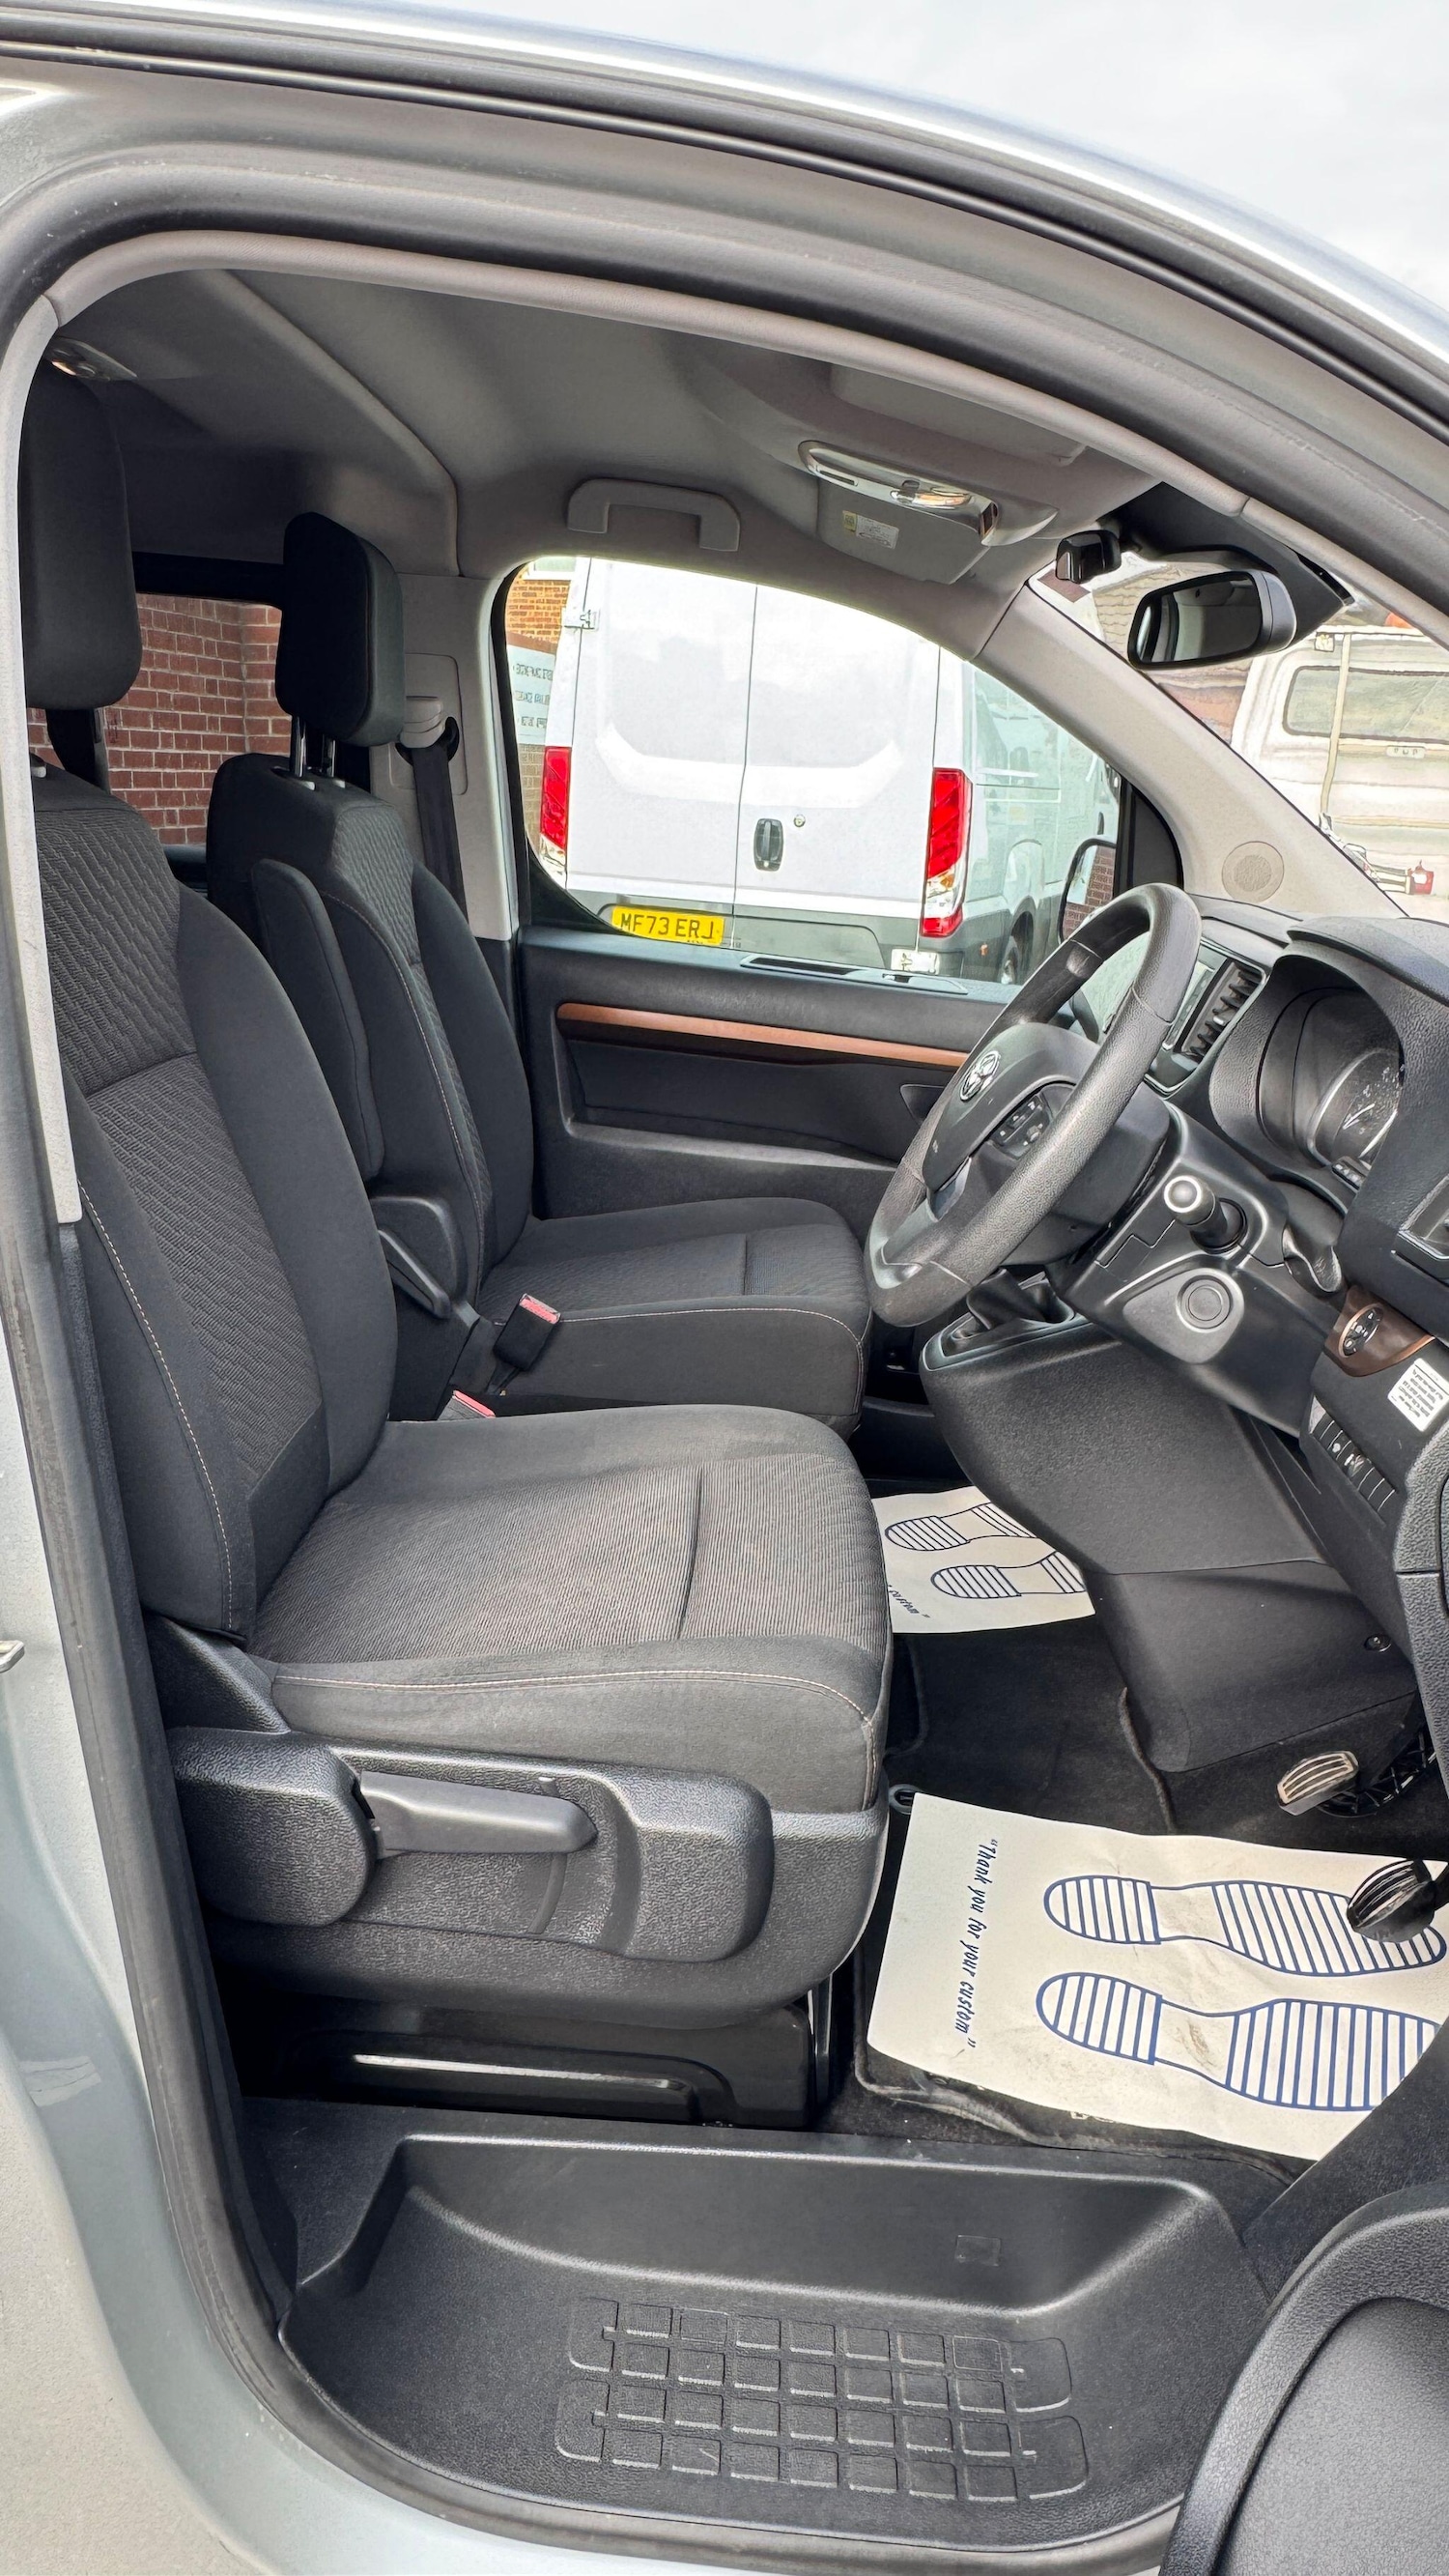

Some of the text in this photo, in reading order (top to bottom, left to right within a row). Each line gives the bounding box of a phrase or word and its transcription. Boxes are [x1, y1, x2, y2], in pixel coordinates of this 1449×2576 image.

[675, 918, 714, 939] ERJ
[967, 1885, 986, 1913] you
[967, 1917, 987, 1939] for
[959, 1939, 980, 1978] your
